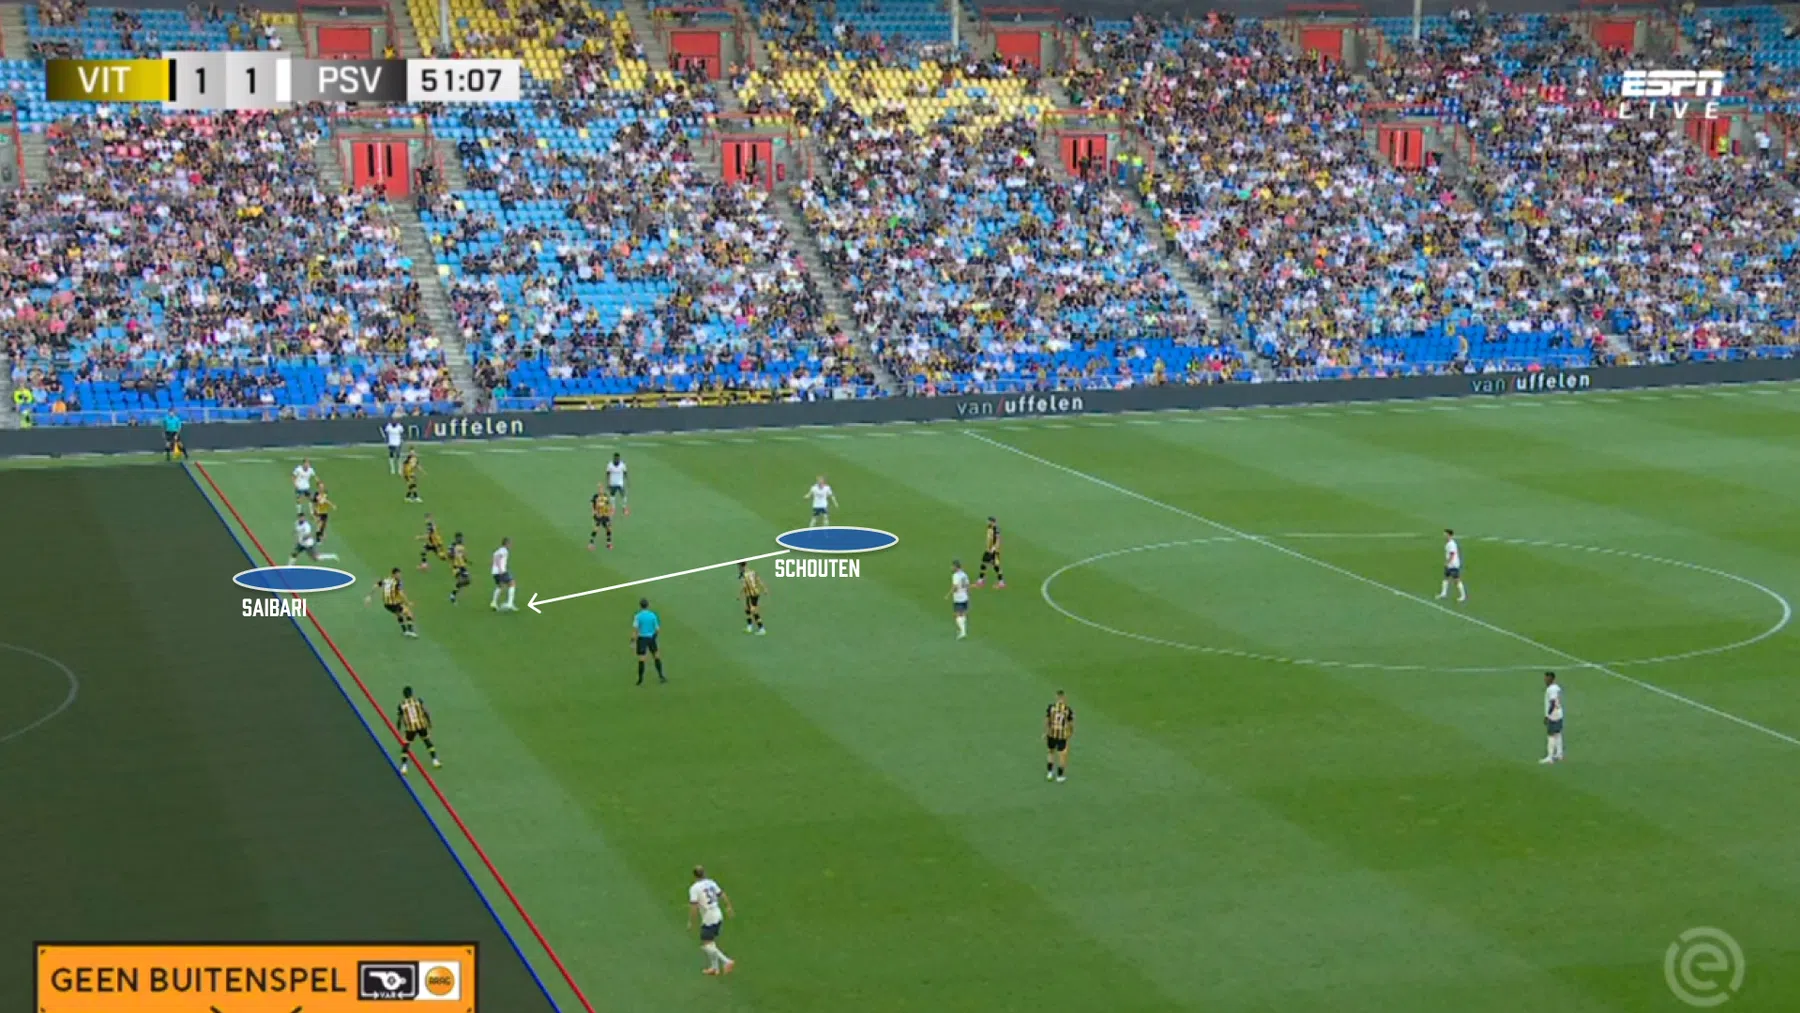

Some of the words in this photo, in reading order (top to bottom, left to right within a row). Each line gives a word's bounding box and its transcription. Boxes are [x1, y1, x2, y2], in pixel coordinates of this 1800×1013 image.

[1471, 377, 1505, 392] van
[1516, 373, 1590, 390] uffelen
[957, 401, 992, 415] van
[1005, 395, 1083, 413] uffelen
[434, 418, 523, 437] uffelen
